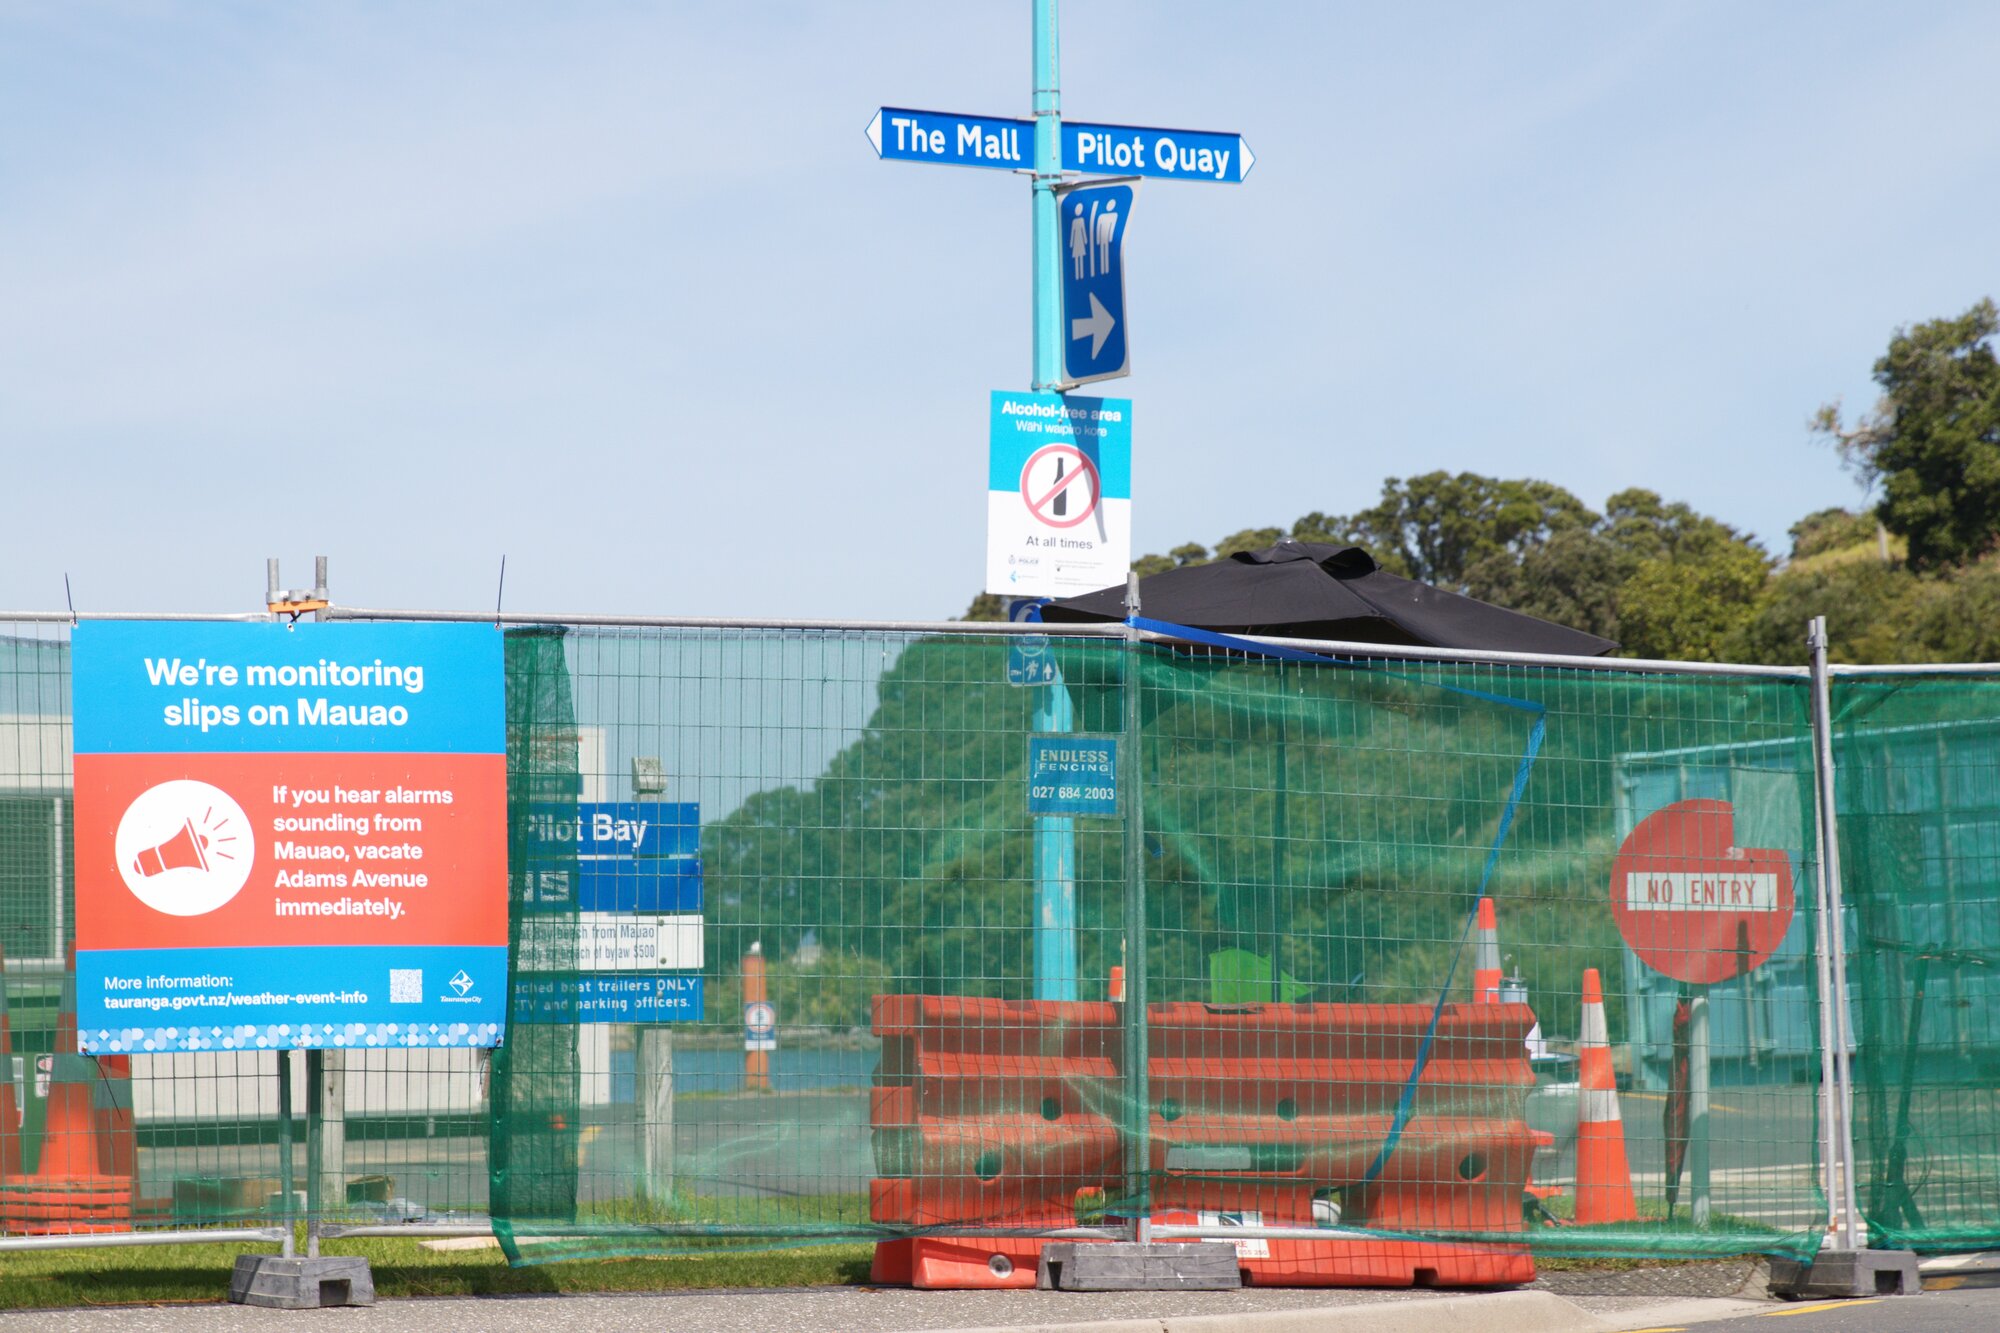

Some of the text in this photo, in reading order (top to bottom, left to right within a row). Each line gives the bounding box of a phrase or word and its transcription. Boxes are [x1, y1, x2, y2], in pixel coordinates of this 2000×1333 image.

[892, 117, 1021, 161] The Mall
[1077, 132, 1230, 180] Pilot Quay
[1001, 400, 1122, 422] Alcohol-free area
[1015, 420, 1107, 437] Wāhi waipiro kore
[1026, 535, 1093, 550] At all times
[246, 658, 424, 694] monitoring
[163, 697, 409, 733] slips on Mauao
[1040, 749, 1108, 763] ENDLESS
[1039, 763, 1109, 772] FENCING
[272, 785, 453, 808] If you hear alarms
[1032, 786, 1114, 800] 027 684 2003
[273, 813, 422, 836] sounding from
[592, 813, 647, 848] Bay
[273, 841, 423, 863] Mauao, vacate
[274, 869, 428, 888] Adams Avenue
[1647, 879, 1756, 904] NO ENTRY
[275, 897, 406, 920] immediately.
[592, 925, 616, 939] from
[620, 925, 654, 939] Mauao
[634, 944, 655, 958] $500
[104, 974, 233, 990] More information:
[515, 978, 696, 994] ached boat trailers ONLY
[104, 990, 368, 1010] tauranga.govt.nz/weather-event-info
[544, 999, 568, 1011] and
[575, 998, 628, 1013] parking
[635, 996, 691, 1008] officers.
